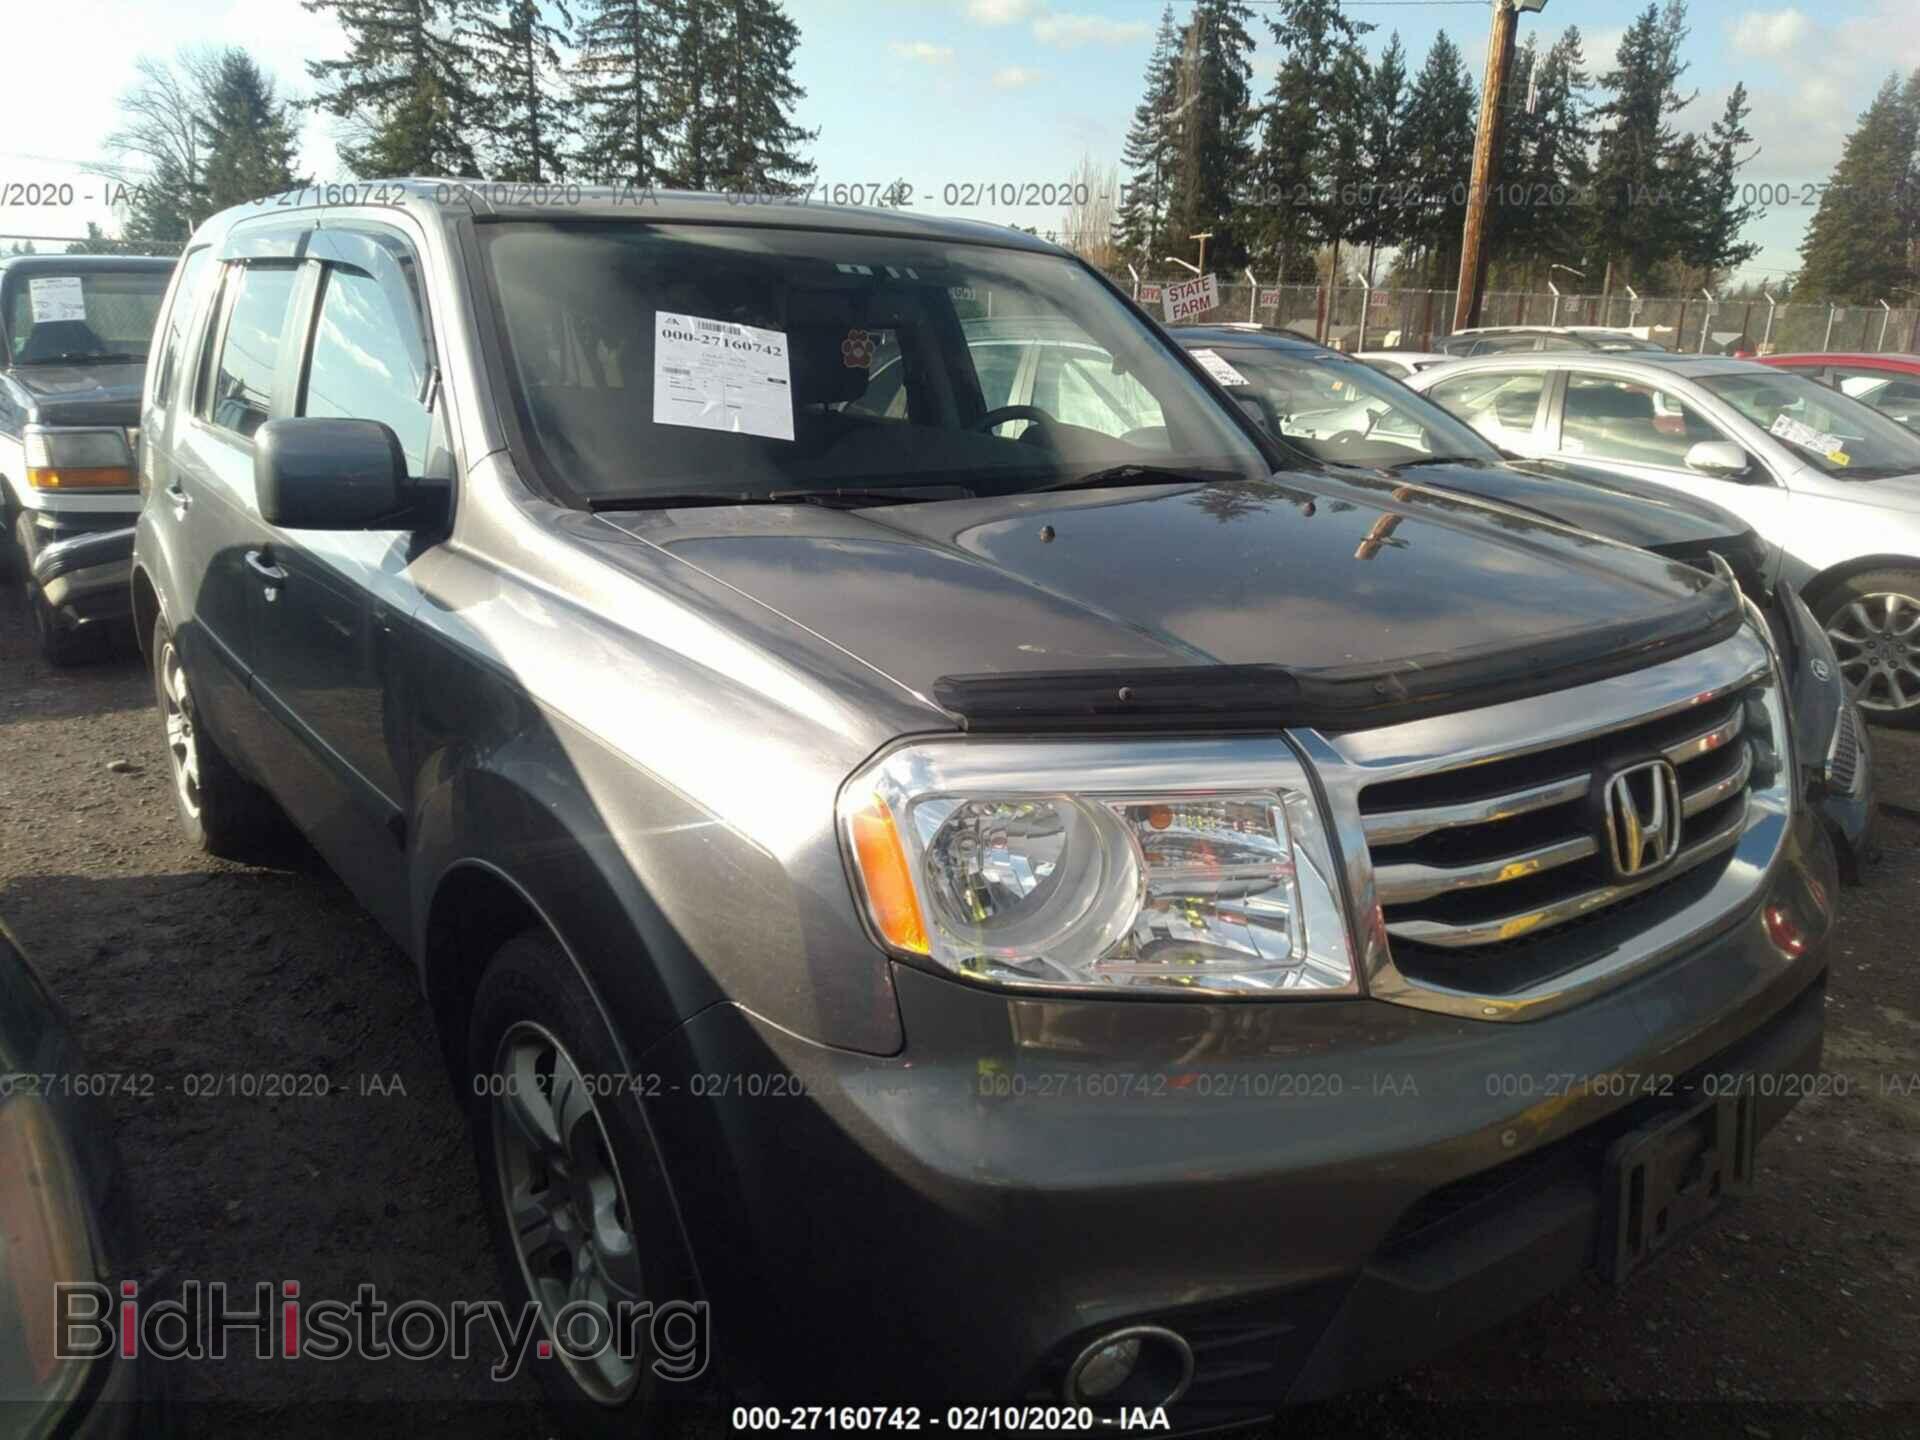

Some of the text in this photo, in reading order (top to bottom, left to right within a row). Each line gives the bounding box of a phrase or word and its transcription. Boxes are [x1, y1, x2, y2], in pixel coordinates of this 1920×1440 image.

[1169, 277, 1210, 302] STATE
[1173, 295, 1210, 319] FARM
[661, 328, 784, 358] 000-27160742
